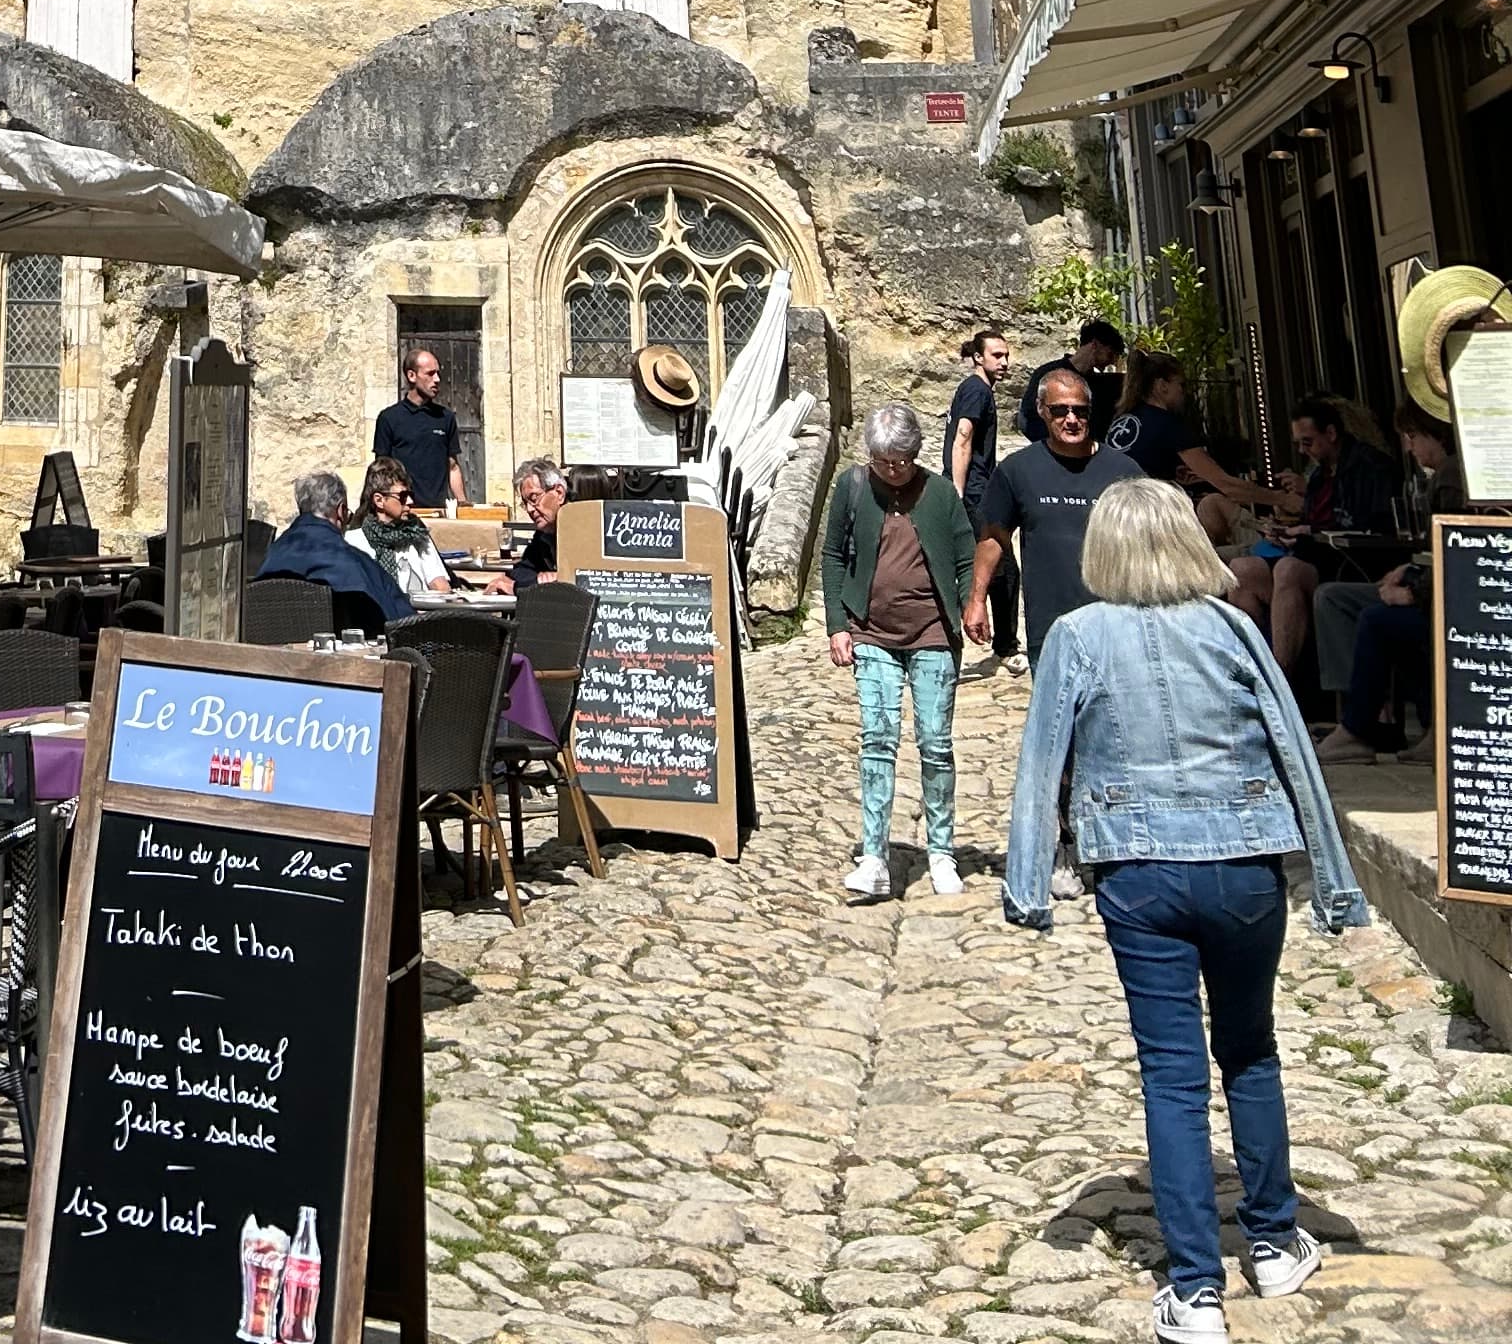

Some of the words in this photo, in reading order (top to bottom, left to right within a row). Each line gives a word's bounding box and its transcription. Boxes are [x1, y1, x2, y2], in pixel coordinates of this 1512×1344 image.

[1039, 496, 1059, 504] NEW
[1063, 496, 1087, 505] YORK
[606, 511, 680, 537] L'Amelia
[616, 526, 674, 548] Canta
[1447, 531, 1487, 548] Menu
[123, 688, 176, 731] Le
[190, 695, 373, 756] Bouchon
[138, 823, 183, 861] Menu
[190, 842, 212, 864] du
[191, 924, 220, 953] de
[234, 921, 295, 963] thon
[85, 1009, 164, 1061] Hampe
[177, 1026, 203, 1054] de
[108, 1063, 169, 1089] sauce
[205, 1116, 278, 1154] salade
[63, 1185, 108, 1236] riz
[117, 1204, 153, 1227] au
[161, 1195, 217, 1236] lait
